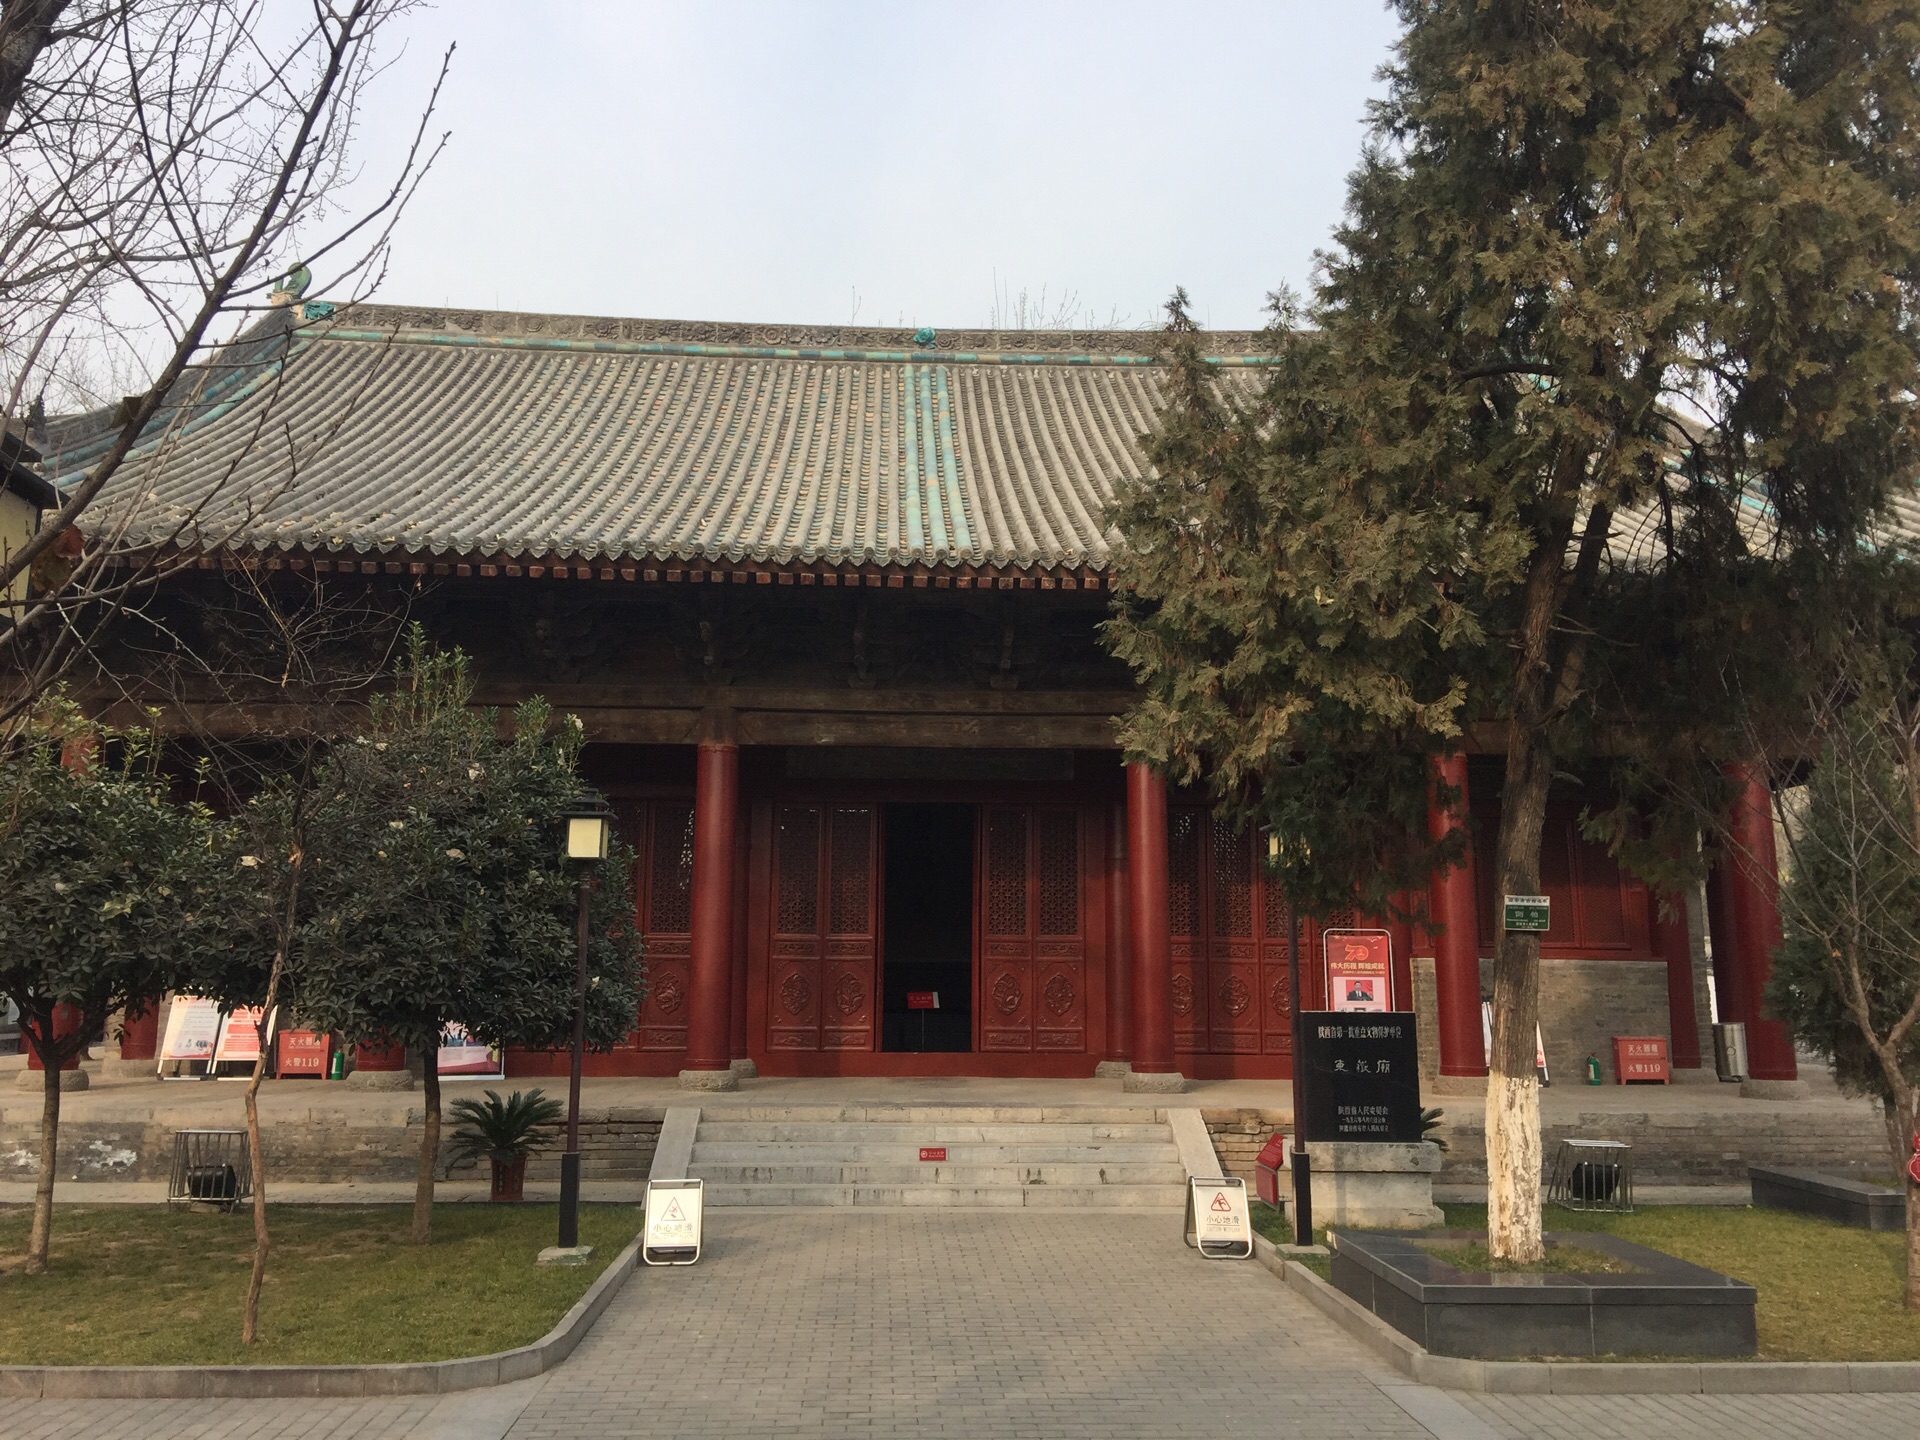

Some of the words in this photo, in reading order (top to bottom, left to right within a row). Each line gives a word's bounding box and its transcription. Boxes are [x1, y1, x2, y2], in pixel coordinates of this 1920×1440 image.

[1330, 962, 1357, 970] 伟大历程
[284, 1057, 320, 1067] 火警119
[1628, 1063, 1661, 1073] 火警119
[1206, 1215, 1240, 1225] 小心地滑
[653, 1223, 693, 1233] 小心地滑
